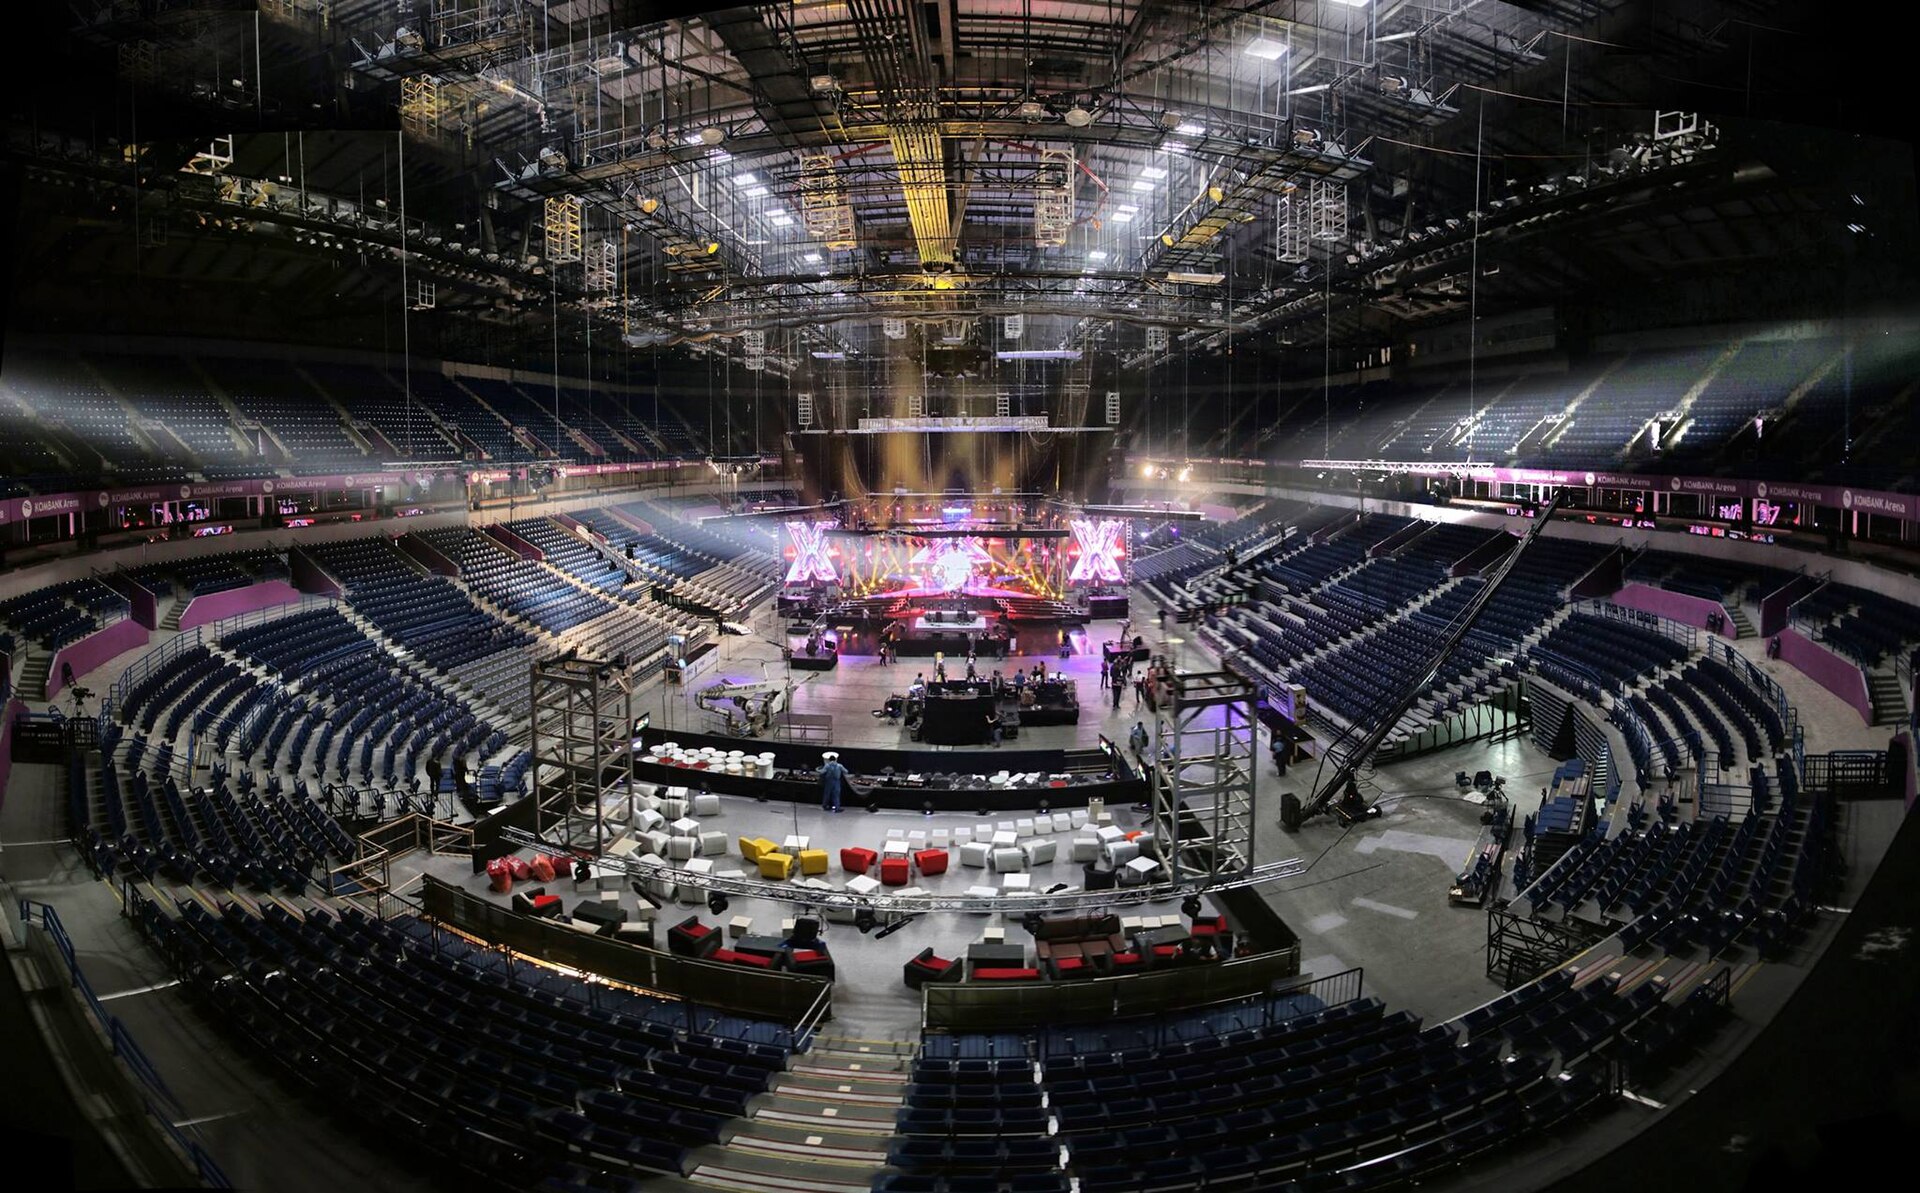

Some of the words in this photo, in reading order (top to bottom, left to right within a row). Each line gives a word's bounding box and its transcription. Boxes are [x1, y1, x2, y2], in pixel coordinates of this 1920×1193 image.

[276, 480, 307, 490] KOMBANK
[308, 480, 327, 488] Arena
[1597, 475, 1629, 484] KOMBANK
[1630, 477, 1650, 486] Arena
[225, 484, 243, 493] Arena
[1683, 481, 1714, 490] KOMBANK
[1715, 482, 1736, 492] Arena
[1800, 489, 1822, 500] Arena
[34, 500, 62, 513] KOMBANK
[63, 499, 80, 509] Arena
[1853, 494, 1884, 507] KOMBANK
[1884, 500, 1906, 513] Arena
